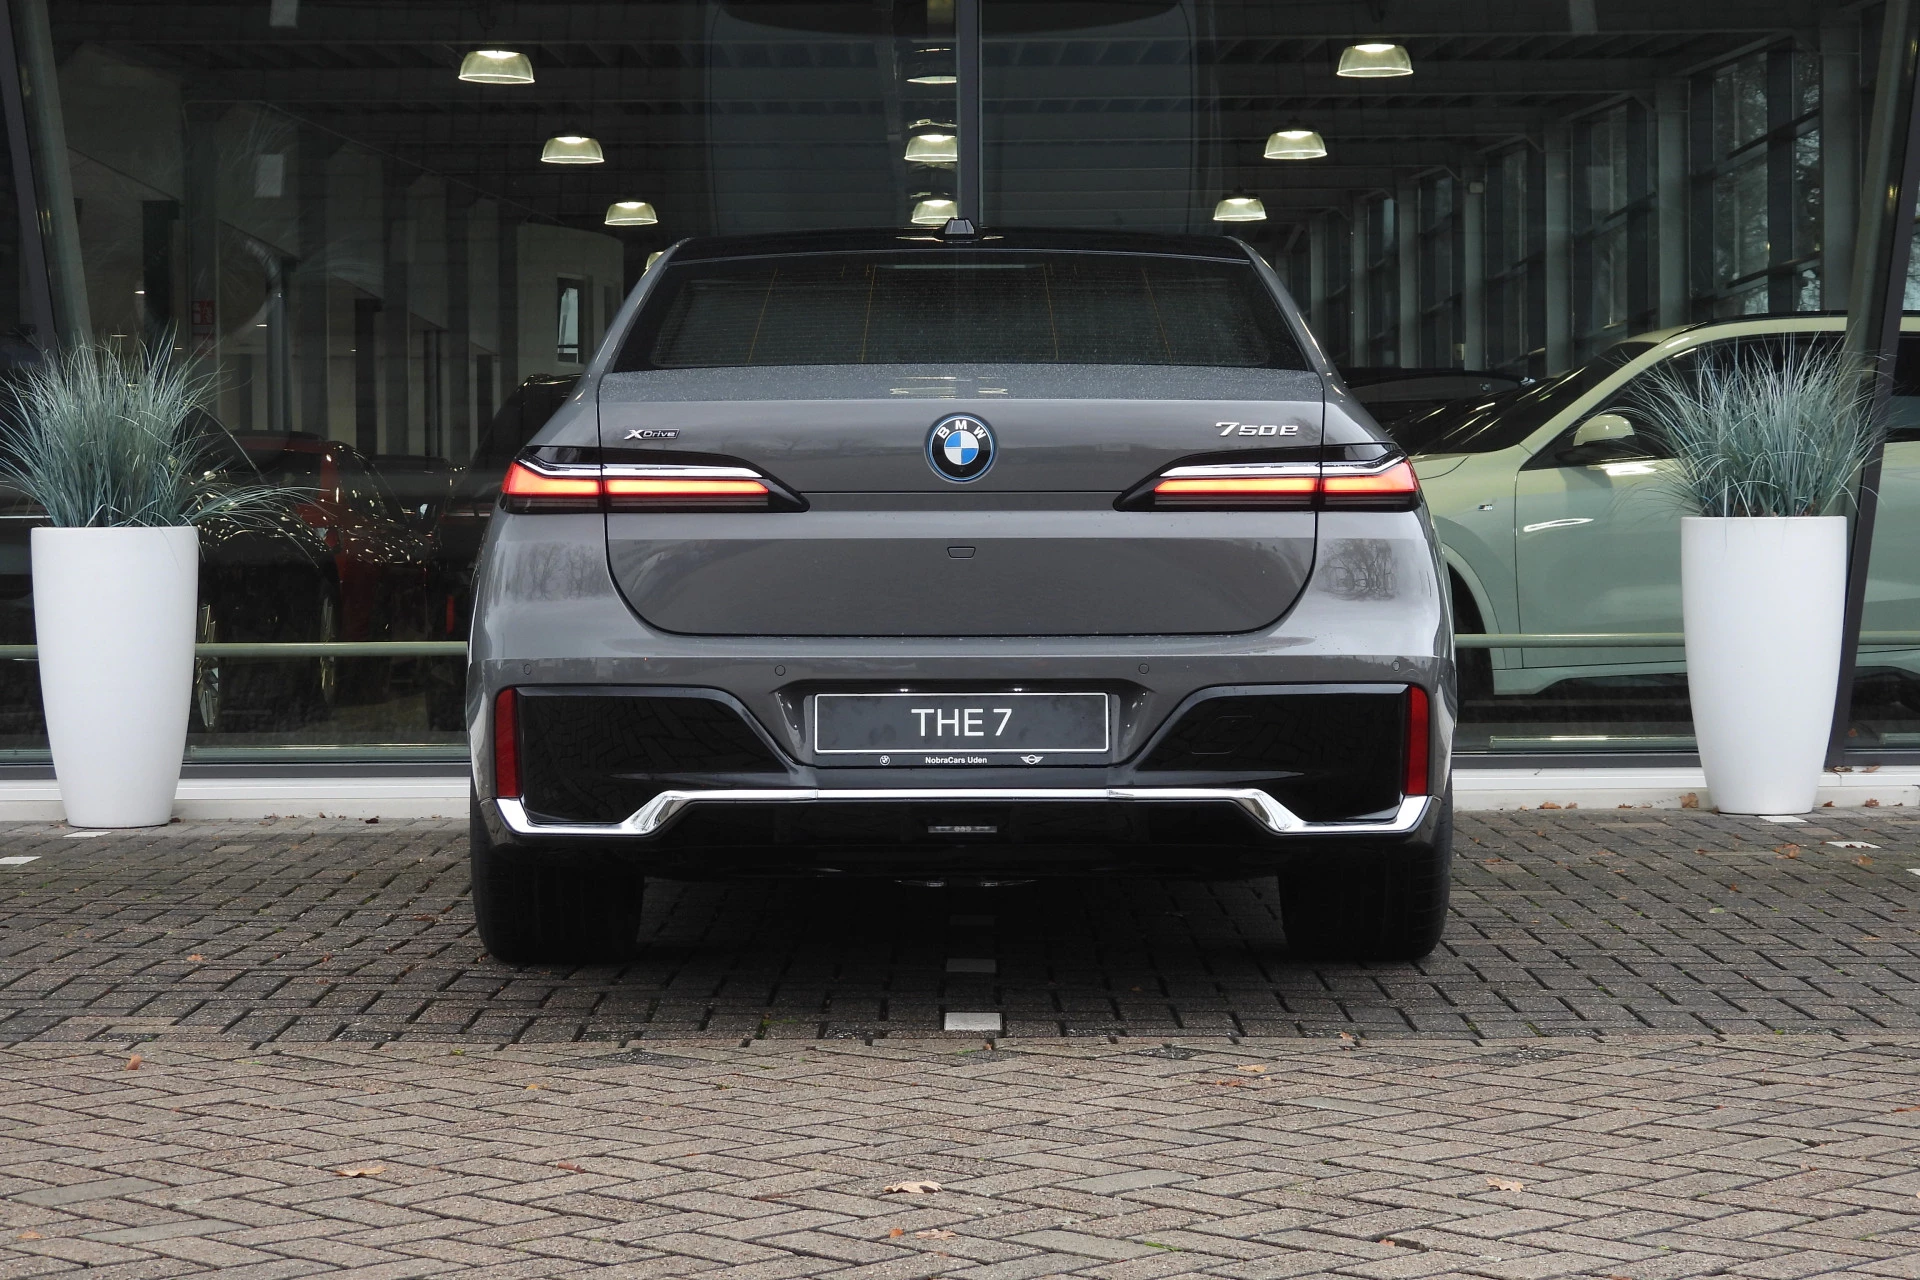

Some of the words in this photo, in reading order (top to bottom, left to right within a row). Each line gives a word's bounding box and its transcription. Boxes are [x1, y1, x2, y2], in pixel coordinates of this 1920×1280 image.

[937, 419, 986, 439] BMW
[1216, 422, 1298, 436] 750e
[911, 709, 984, 736] THE
[993, 709, 1012, 736] 7
[925, 756, 965, 764] NobraCars
[967, 756, 987, 764] Uden
